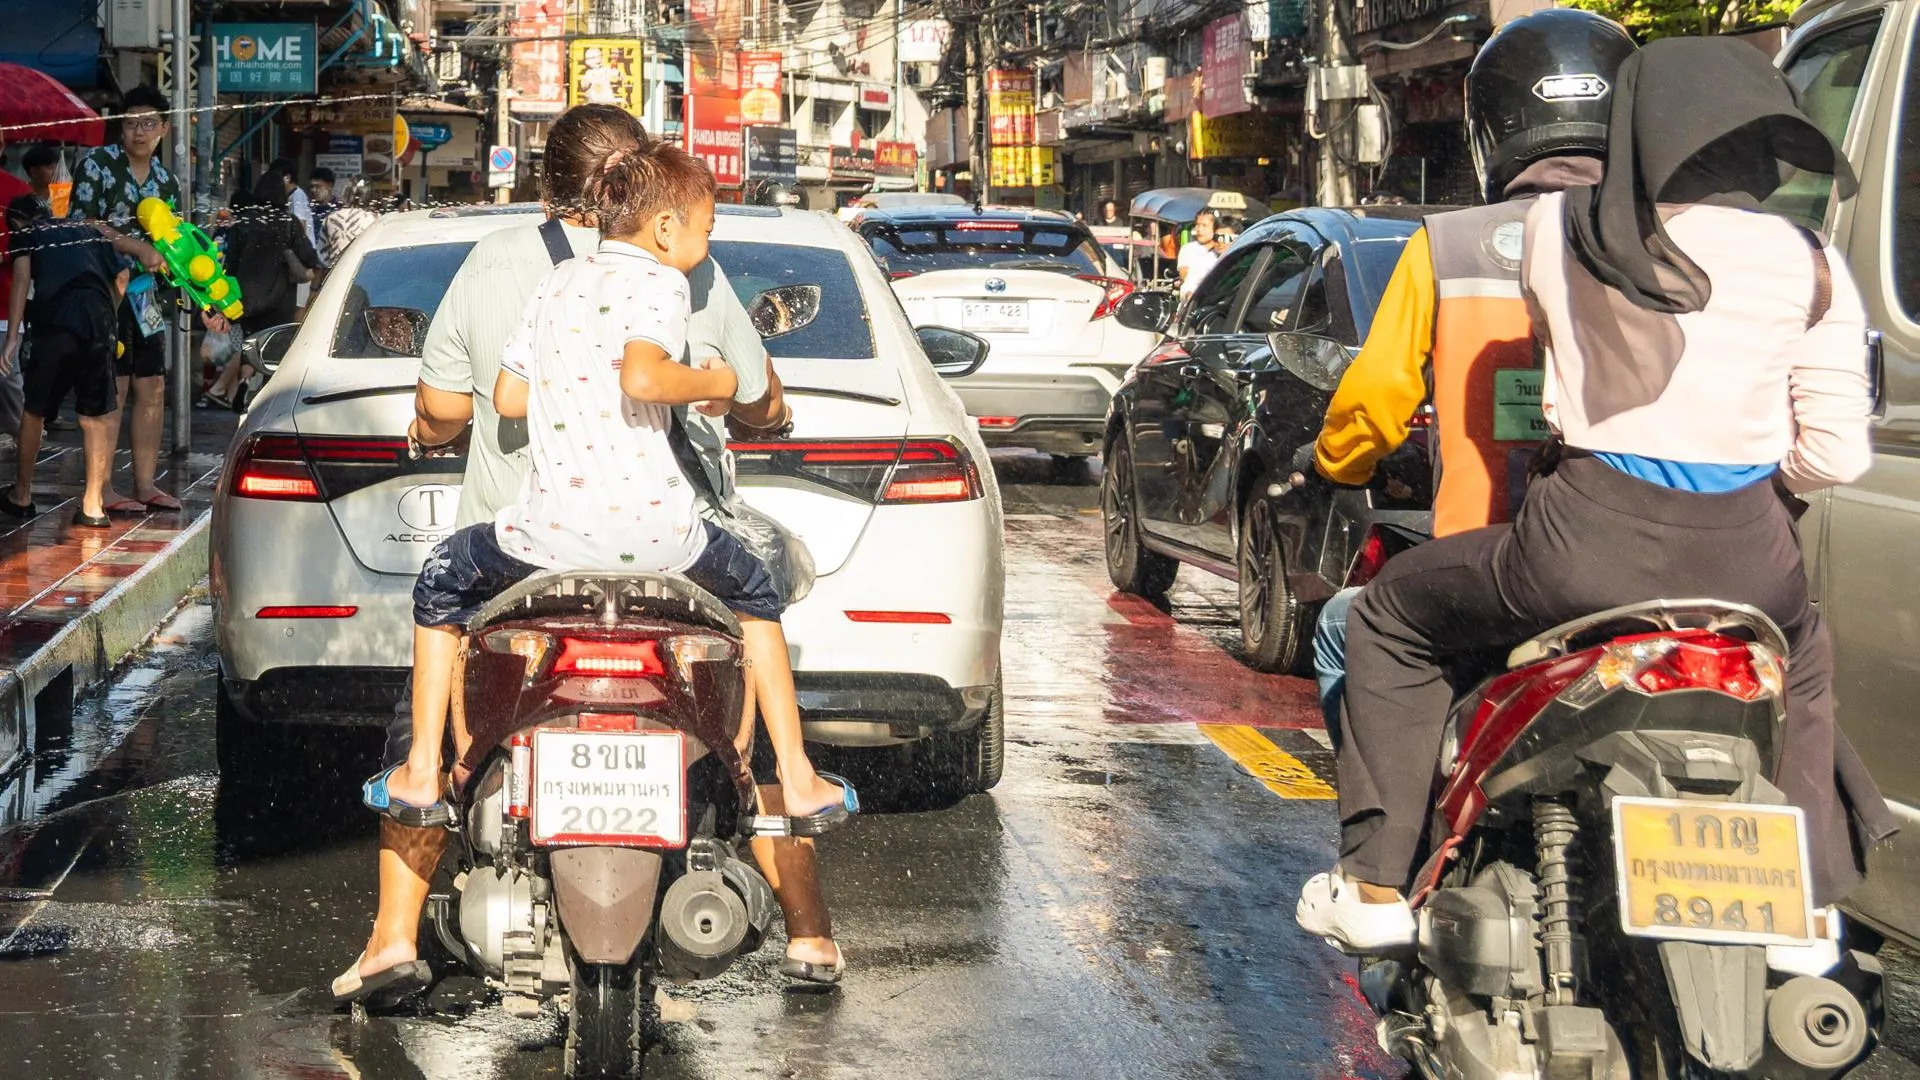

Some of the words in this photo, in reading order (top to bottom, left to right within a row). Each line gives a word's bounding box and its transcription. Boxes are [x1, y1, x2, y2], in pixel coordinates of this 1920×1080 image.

[693, 128, 715, 146] PANDA
[543, 780, 671, 799] กรุงเทพมหานคร
[561, 806, 658, 834] 2022
[1632, 858, 1797, 888] กรุงเทพมหานคร
[1654, 893, 1775, 934] 8941
